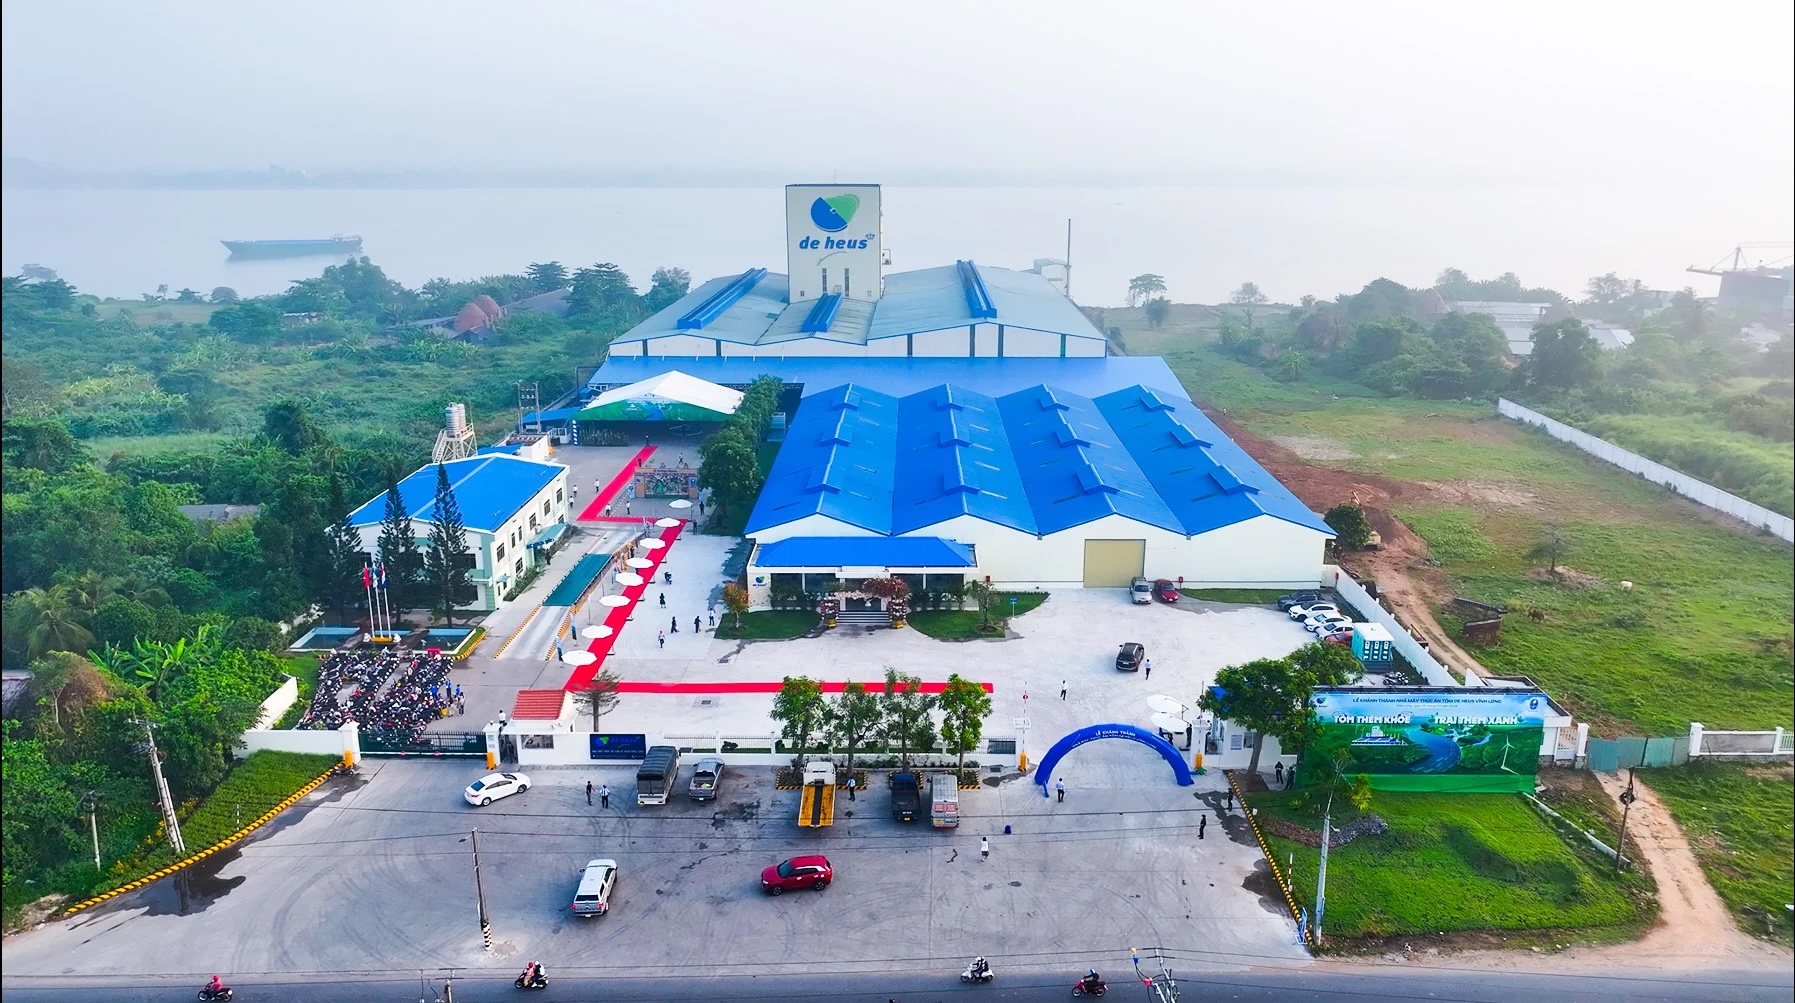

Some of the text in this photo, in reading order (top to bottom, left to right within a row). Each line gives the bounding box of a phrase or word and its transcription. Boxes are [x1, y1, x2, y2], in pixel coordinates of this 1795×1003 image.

[799, 236, 868, 249] de heus
[1488, 716, 1518, 724] XANH
